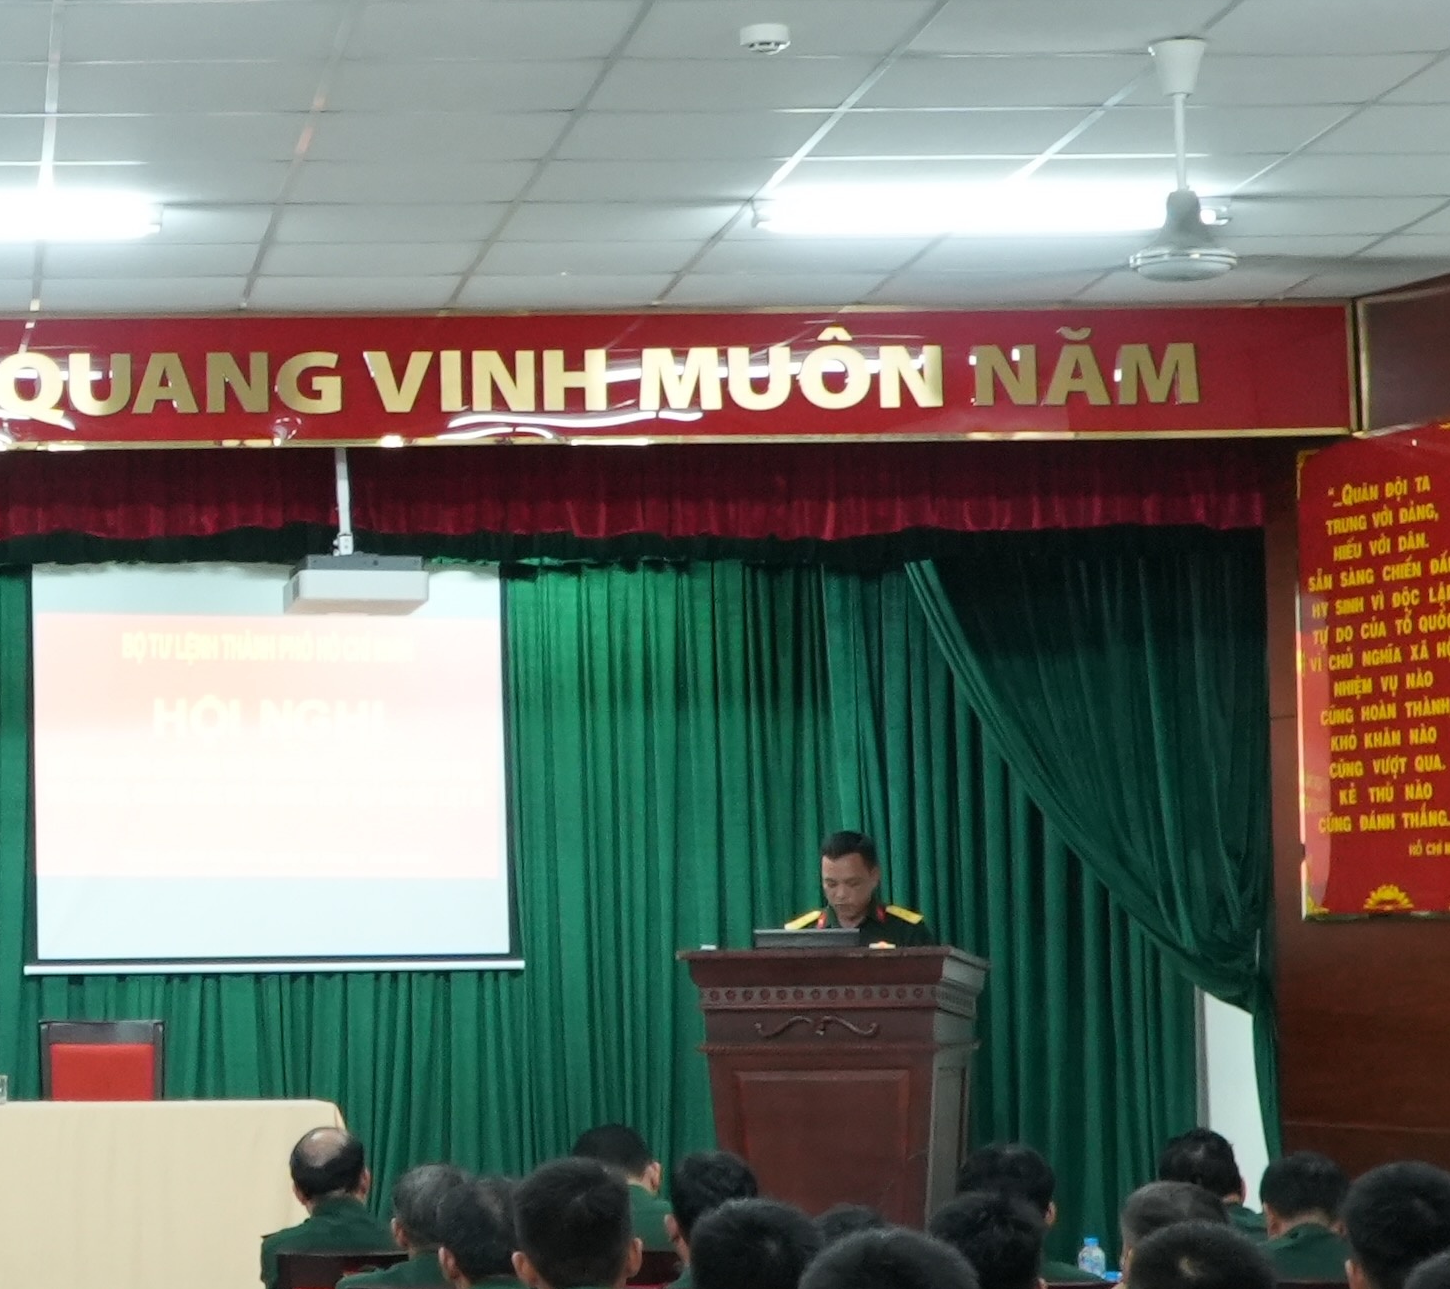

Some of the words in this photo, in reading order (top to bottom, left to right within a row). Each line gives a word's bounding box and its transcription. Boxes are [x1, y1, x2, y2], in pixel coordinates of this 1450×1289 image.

[366, 347, 606, 413] VINH
[639, 329, 942, 413] MUÔN
[973, 326, 1200, 407] NĂM
[1386, 477, 1408, 501] ĐỘI
[1415, 475, 1431, 492] TA
[1326, 514, 1367, 535] TRUNG
[1340, 567, 1374, 587] SÀNG
[1336, 626, 1353, 643] DO
[1361, 617, 1386, 639] CỦA
[147, 632, 175, 661] TƯ
[1329, 647, 1353, 670] CHỦ
[1381, 676, 1398, 697] VỤ
[1406, 668, 1433, 690] NÀO
[152, 694, 243, 748] HỘI
